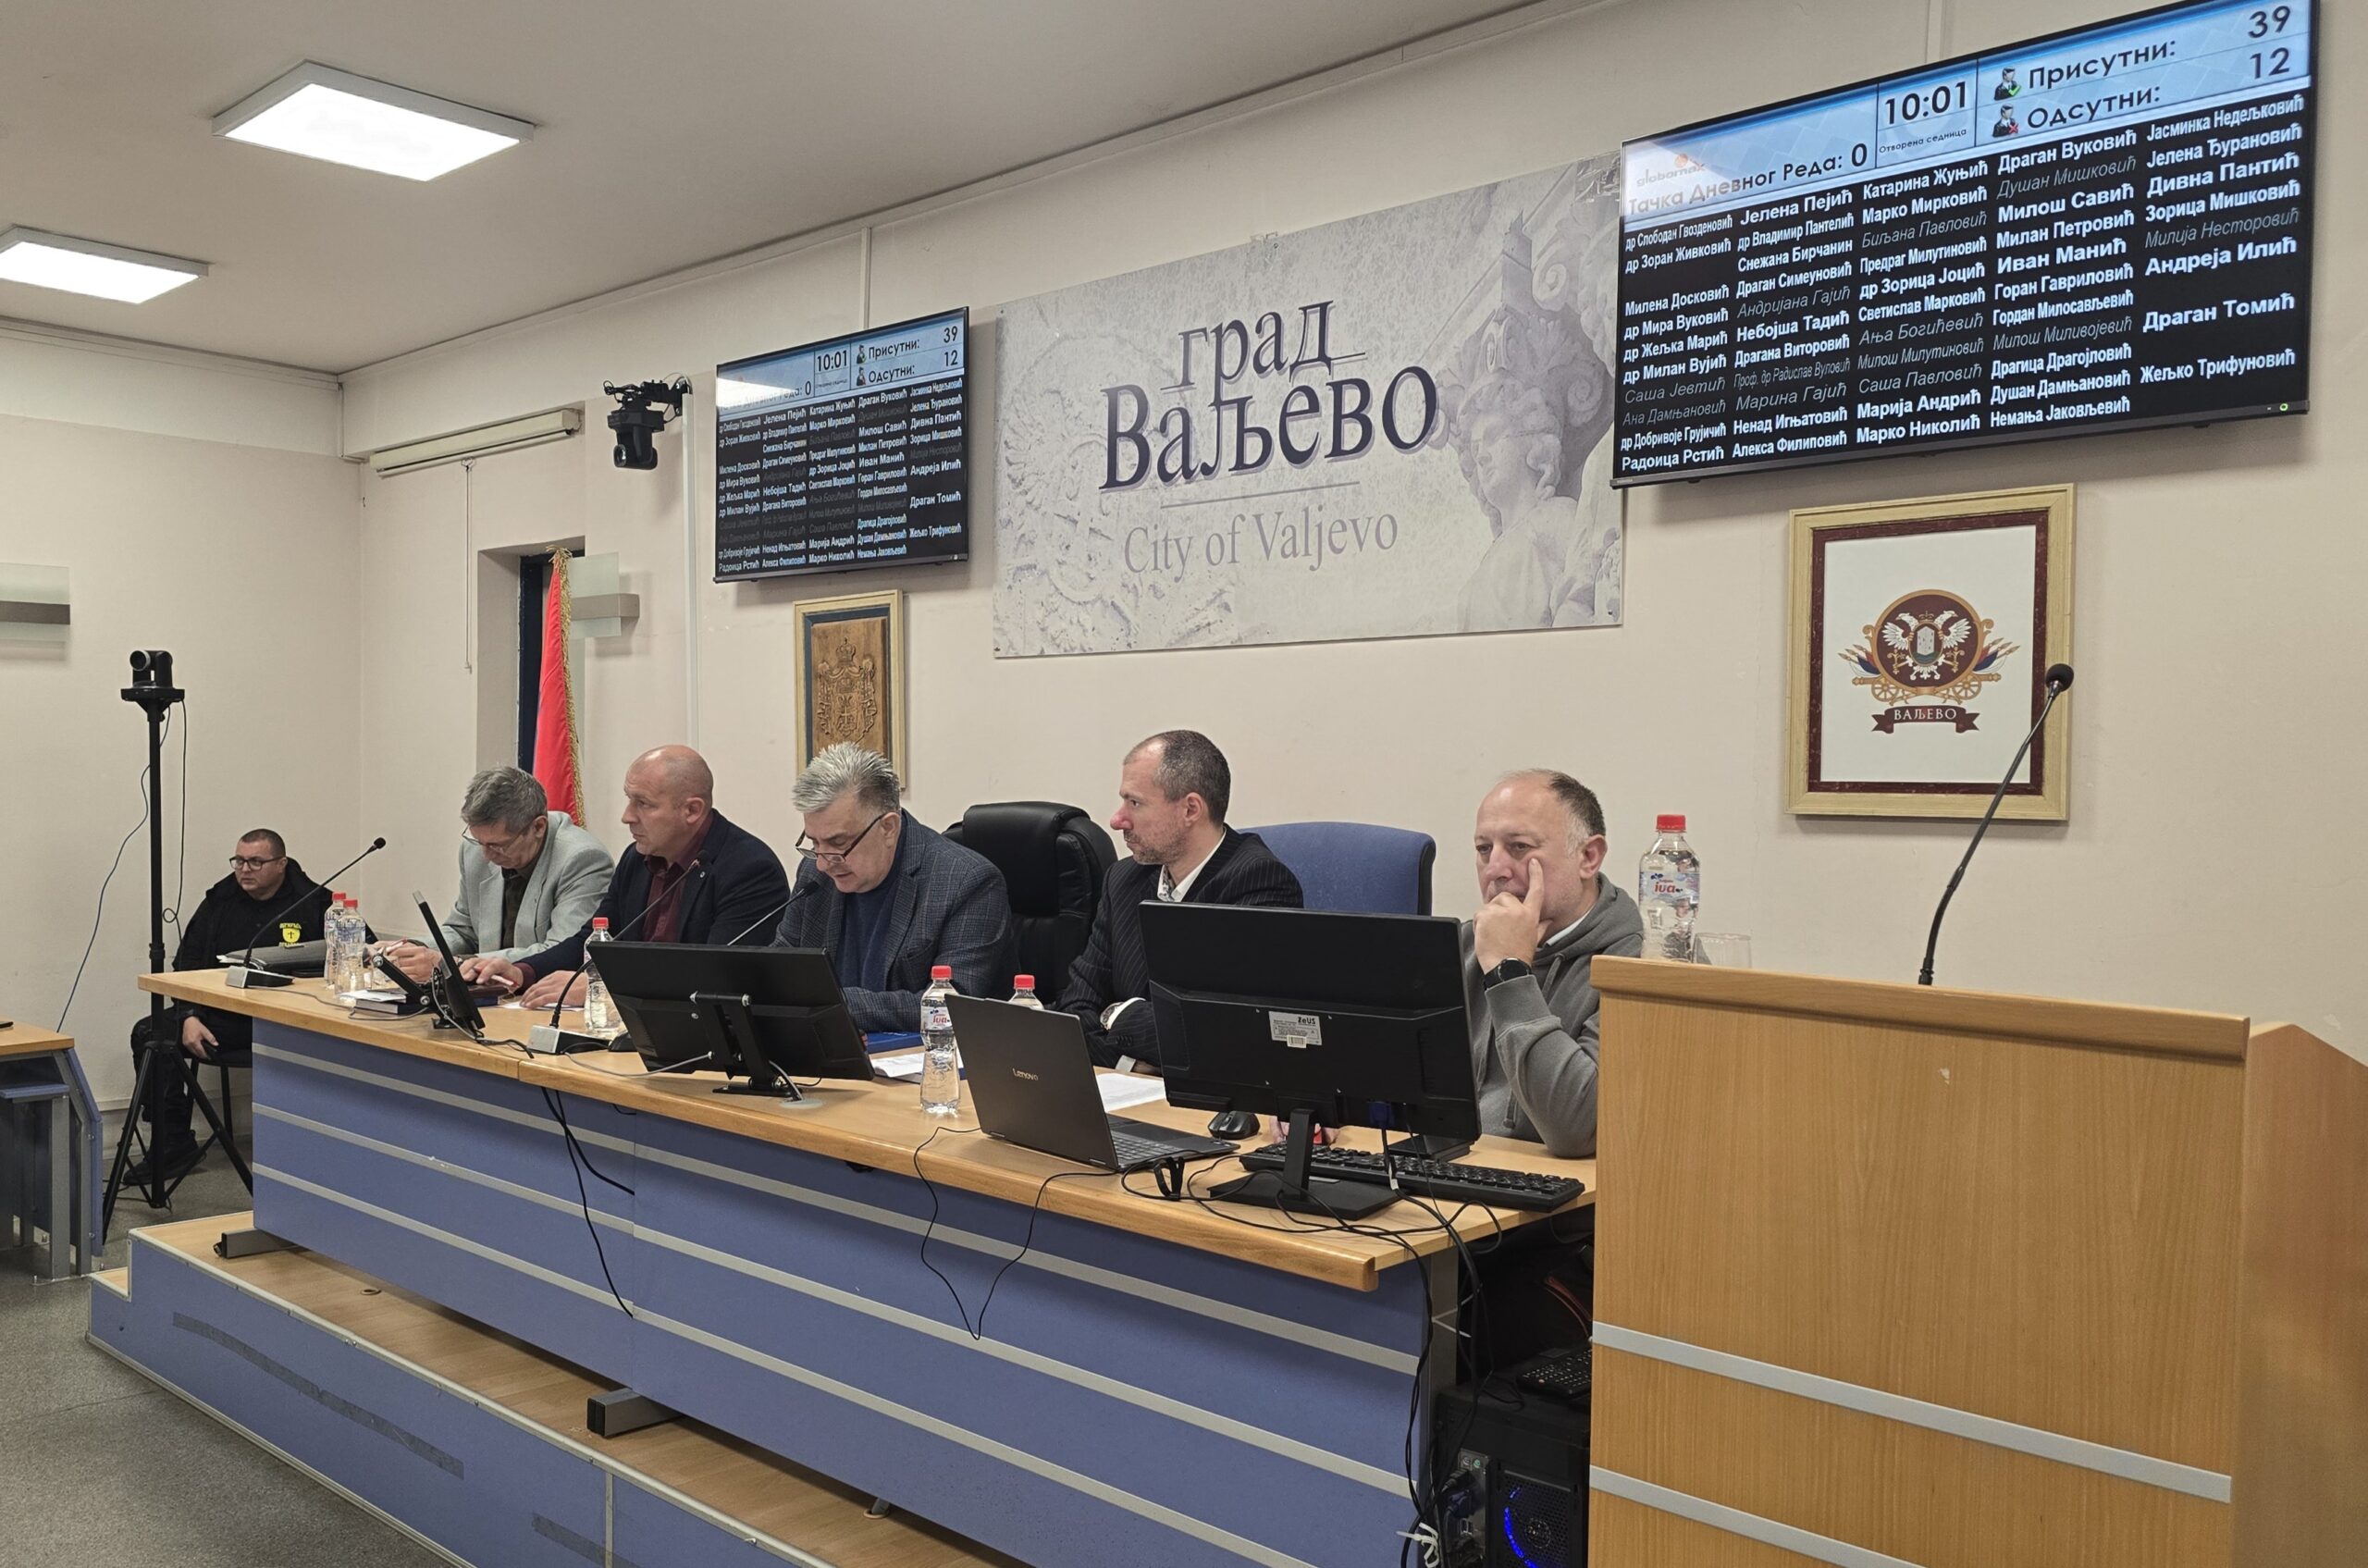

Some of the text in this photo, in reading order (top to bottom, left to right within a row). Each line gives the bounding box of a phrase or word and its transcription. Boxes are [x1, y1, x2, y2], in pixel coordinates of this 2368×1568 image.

[2029, 6, 2291, 90] Присутни: 39
[1885, 81, 1966, 124] 10:01
[2028, 47, 2289, 130] Одсутни: 12
[2147, 93, 2305, 142] Јасминка Недељковић
[1879, 130, 1967, 154] Отворена седница
[1997, 129, 2137, 176] Драган Вуковић
[2146, 122, 2303, 168] Јелена Ђурановић
[1629, 142, 1868, 216] Тачка Дневног Реда: 0
[1863, 159, 1988, 200] Катарина Жуњић
[1996, 154, 2137, 200] Душан Мишковић
[2146, 151, 2300, 198] Дивна Пантић
[1740, 189, 1853, 226] Јелена Пејић
[1862, 185, 1988, 225] Марко Мирковић
[1998, 182, 2135, 223] Милош Савић
[2145, 179, 2300, 223] Зорица Мишковић
[1625, 214, 1733, 252] др Слободан Гвозденовић
[1737, 212, 1854, 252] др Владимир Пантелић
[1862, 211, 1988, 248] Биљана Павловић
[1996, 209, 2135, 250] Милан Петровић
[2145, 207, 2300, 248] Милија Несторовић
[1625, 238, 1732, 274] др Зоран Живковић
[1738, 240, 1853, 272] Снежана Бирчанин
[1859, 235, 1987, 275] Предраг Милутиновић
[1997, 237, 2127, 275] Иван Манић
[2144, 236, 2297, 276] Андреја Илић
[1736, 261, 1852, 299] Драган Симеуновић
[1859, 262, 1985, 300] др Зорица Јоцић
[1994, 263, 2134, 301] Горан Гавриловић
[1625, 284, 1730, 316] Милена Досковић
[1737, 285, 1851, 318] Андријана Гајић
[1858, 287, 1986, 322] Светислав Марковић
[1992, 289, 2134, 327] Гордан Милосављевић
[2142, 292, 2295, 333] Драган Томић
[1623, 307, 1729, 340] др Мира Вуковић
[1736, 310, 1850, 342] Небојша Тадић
[1858, 312, 1984, 346] Ања Богићевић
[1992, 315, 2133, 351] Милош Миливојевић
[817, 350, 847, 371] 10:01
[869, 326, 958, 360] Присутни: 39
[1161, 300, 1366, 407] град
[1623, 330, 1728, 363] др Жељка Марић
[1734, 333, 1850, 368] Драгана Виторовић
[1857, 337, 1984, 369] Милош Милутиновић
[1991, 342, 2132, 380] Драгица Драгојловић
[868, 350, 958, 383] Одсутни: 12
[1623, 353, 1727, 385] др Милан Вујић
[1858, 363, 1983, 393] Саша Павловић
[2140, 348, 2296, 384] Жељко Трифуновић
[806, 381, 811, 395] 0
[1625, 377, 1725, 403] Саша Јевтић
[1736, 382, 1847, 411] Марина Гајић
[1857, 389, 1981, 419] Марија Андрић
[1990, 369, 2131, 405] Душан Дамњановић
[1098, 364, 1439, 494] Ваљево
[1622, 399, 1726, 426] Ана Дамњановић
[1733, 406, 1848, 435] Ненад Игњатовић
[1856, 414, 1980, 444] Марко Николић
[1990, 396, 2130, 428] Немања Јаковљевић
[1621, 422, 1727, 451] др Добривоје Грујичић
[1732, 430, 1847, 458] Алекса Филиповић
[1622, 446, 1724, 471] Радоица Рстић
[1125, 506, 1399, 584] City of Valjevo
[1893, 708, 1958, 721] ВАЉЕВО
[1012, 1068, 1039, 1080] Lenovo
